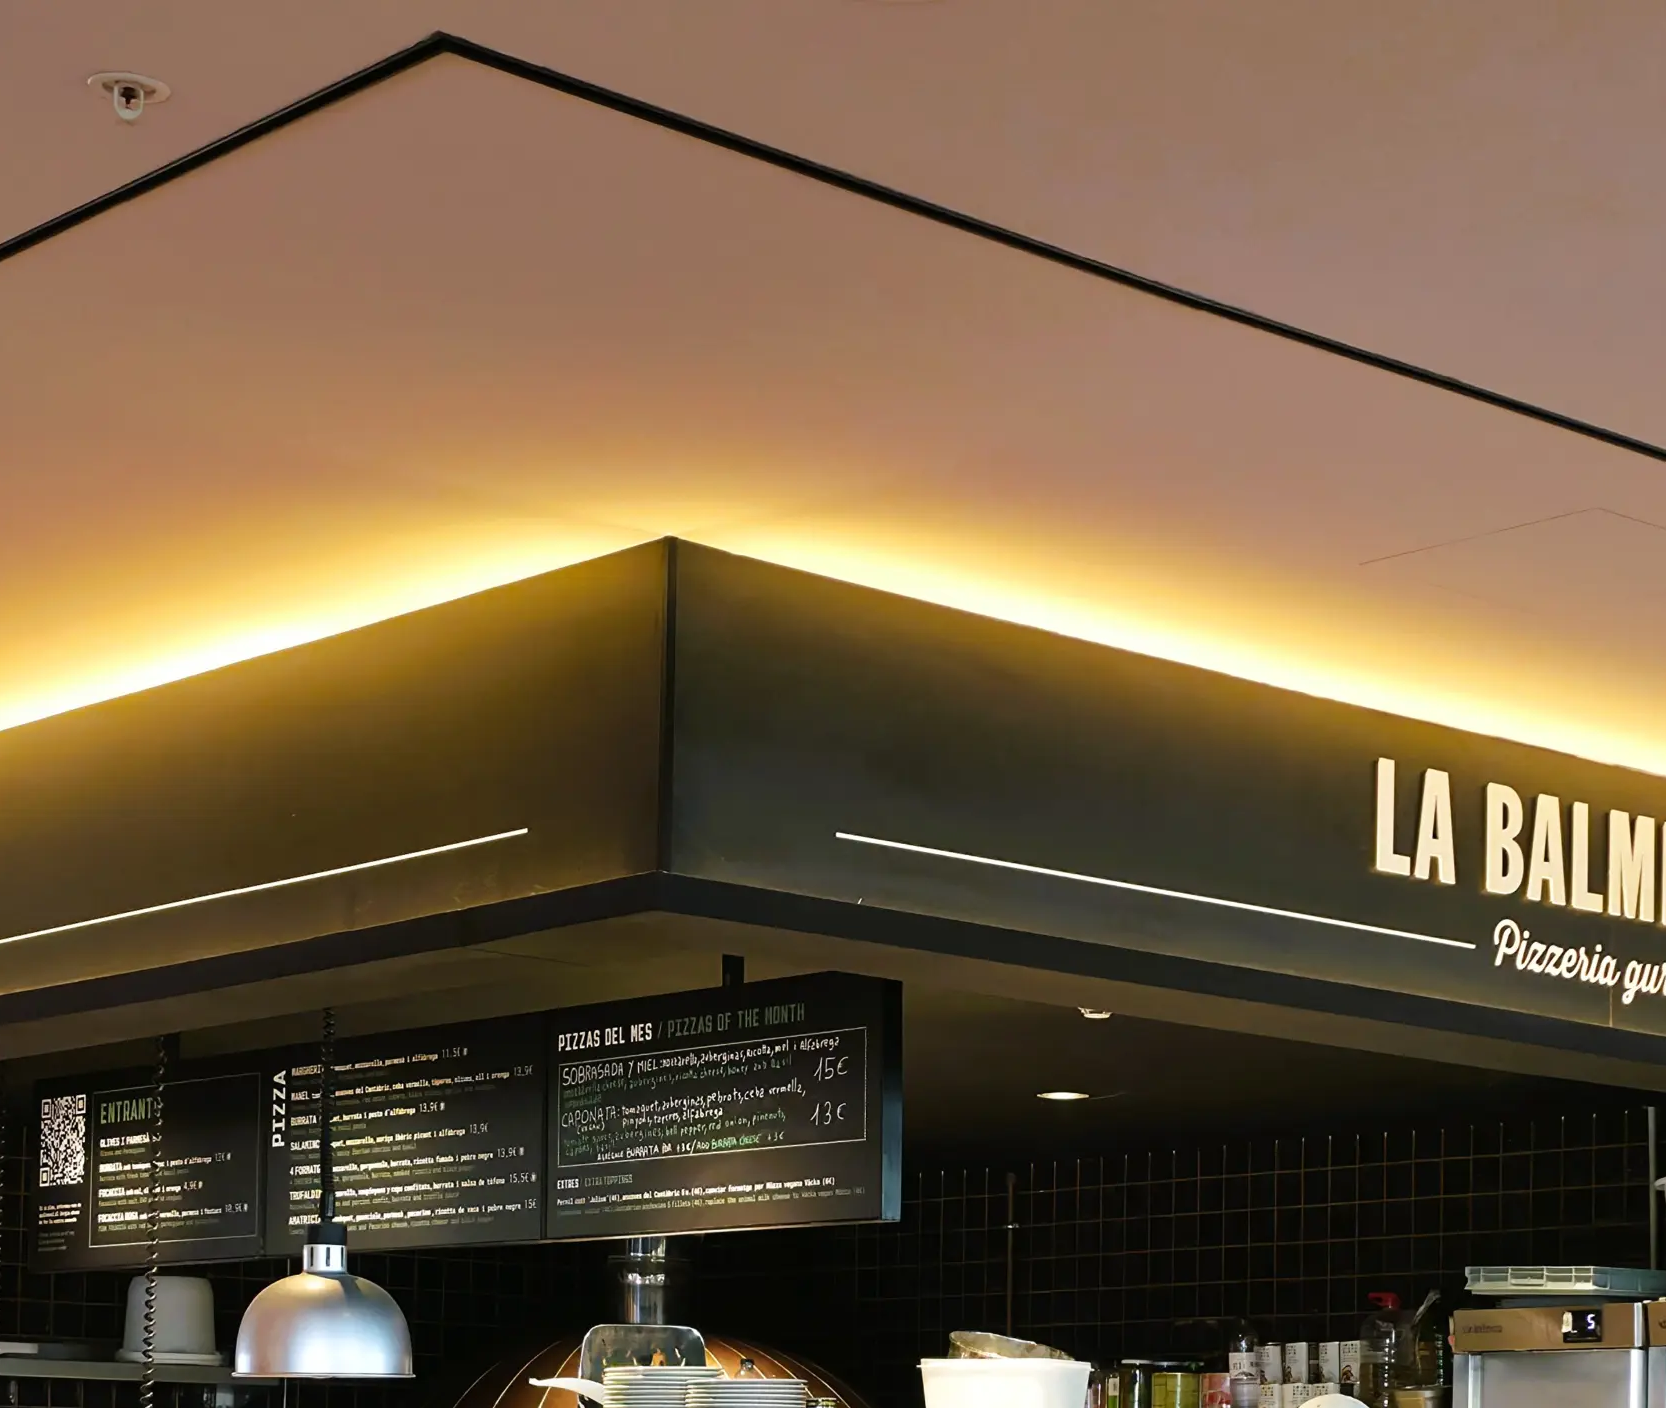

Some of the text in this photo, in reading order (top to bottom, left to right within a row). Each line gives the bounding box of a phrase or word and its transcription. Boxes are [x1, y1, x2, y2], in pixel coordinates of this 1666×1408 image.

[1375, 757, 1456, 885] LA
[1493, 918, 1621, 987] Pizzeria
[558, 1030, 601, 1052] PIZZAS
[604, 1027, 625, 1046] DEL
[630, 1022, 653, 1043] MES
[667, 1014, 713, 1039] PIZZAS
[717, 1012, 732, 1031] OF
[737, 1008, 760, 1030] THE
[764, 1002, 805, 1025] MONTH
[562, 1062, 623, 1086] SOBRASADA
[628, 1060, 634, 1078] Y
[814, 1056, 849, 1081] 15€
[272, 1070, 287, 1147] PIZZA
[561, 1105, 620, 1128] CAPONATA:
[810, 1101, 846, 1126] 13€
[289, 1166, 294, 1175] 4
[557, 1178, 579, 1190] EXTRES
